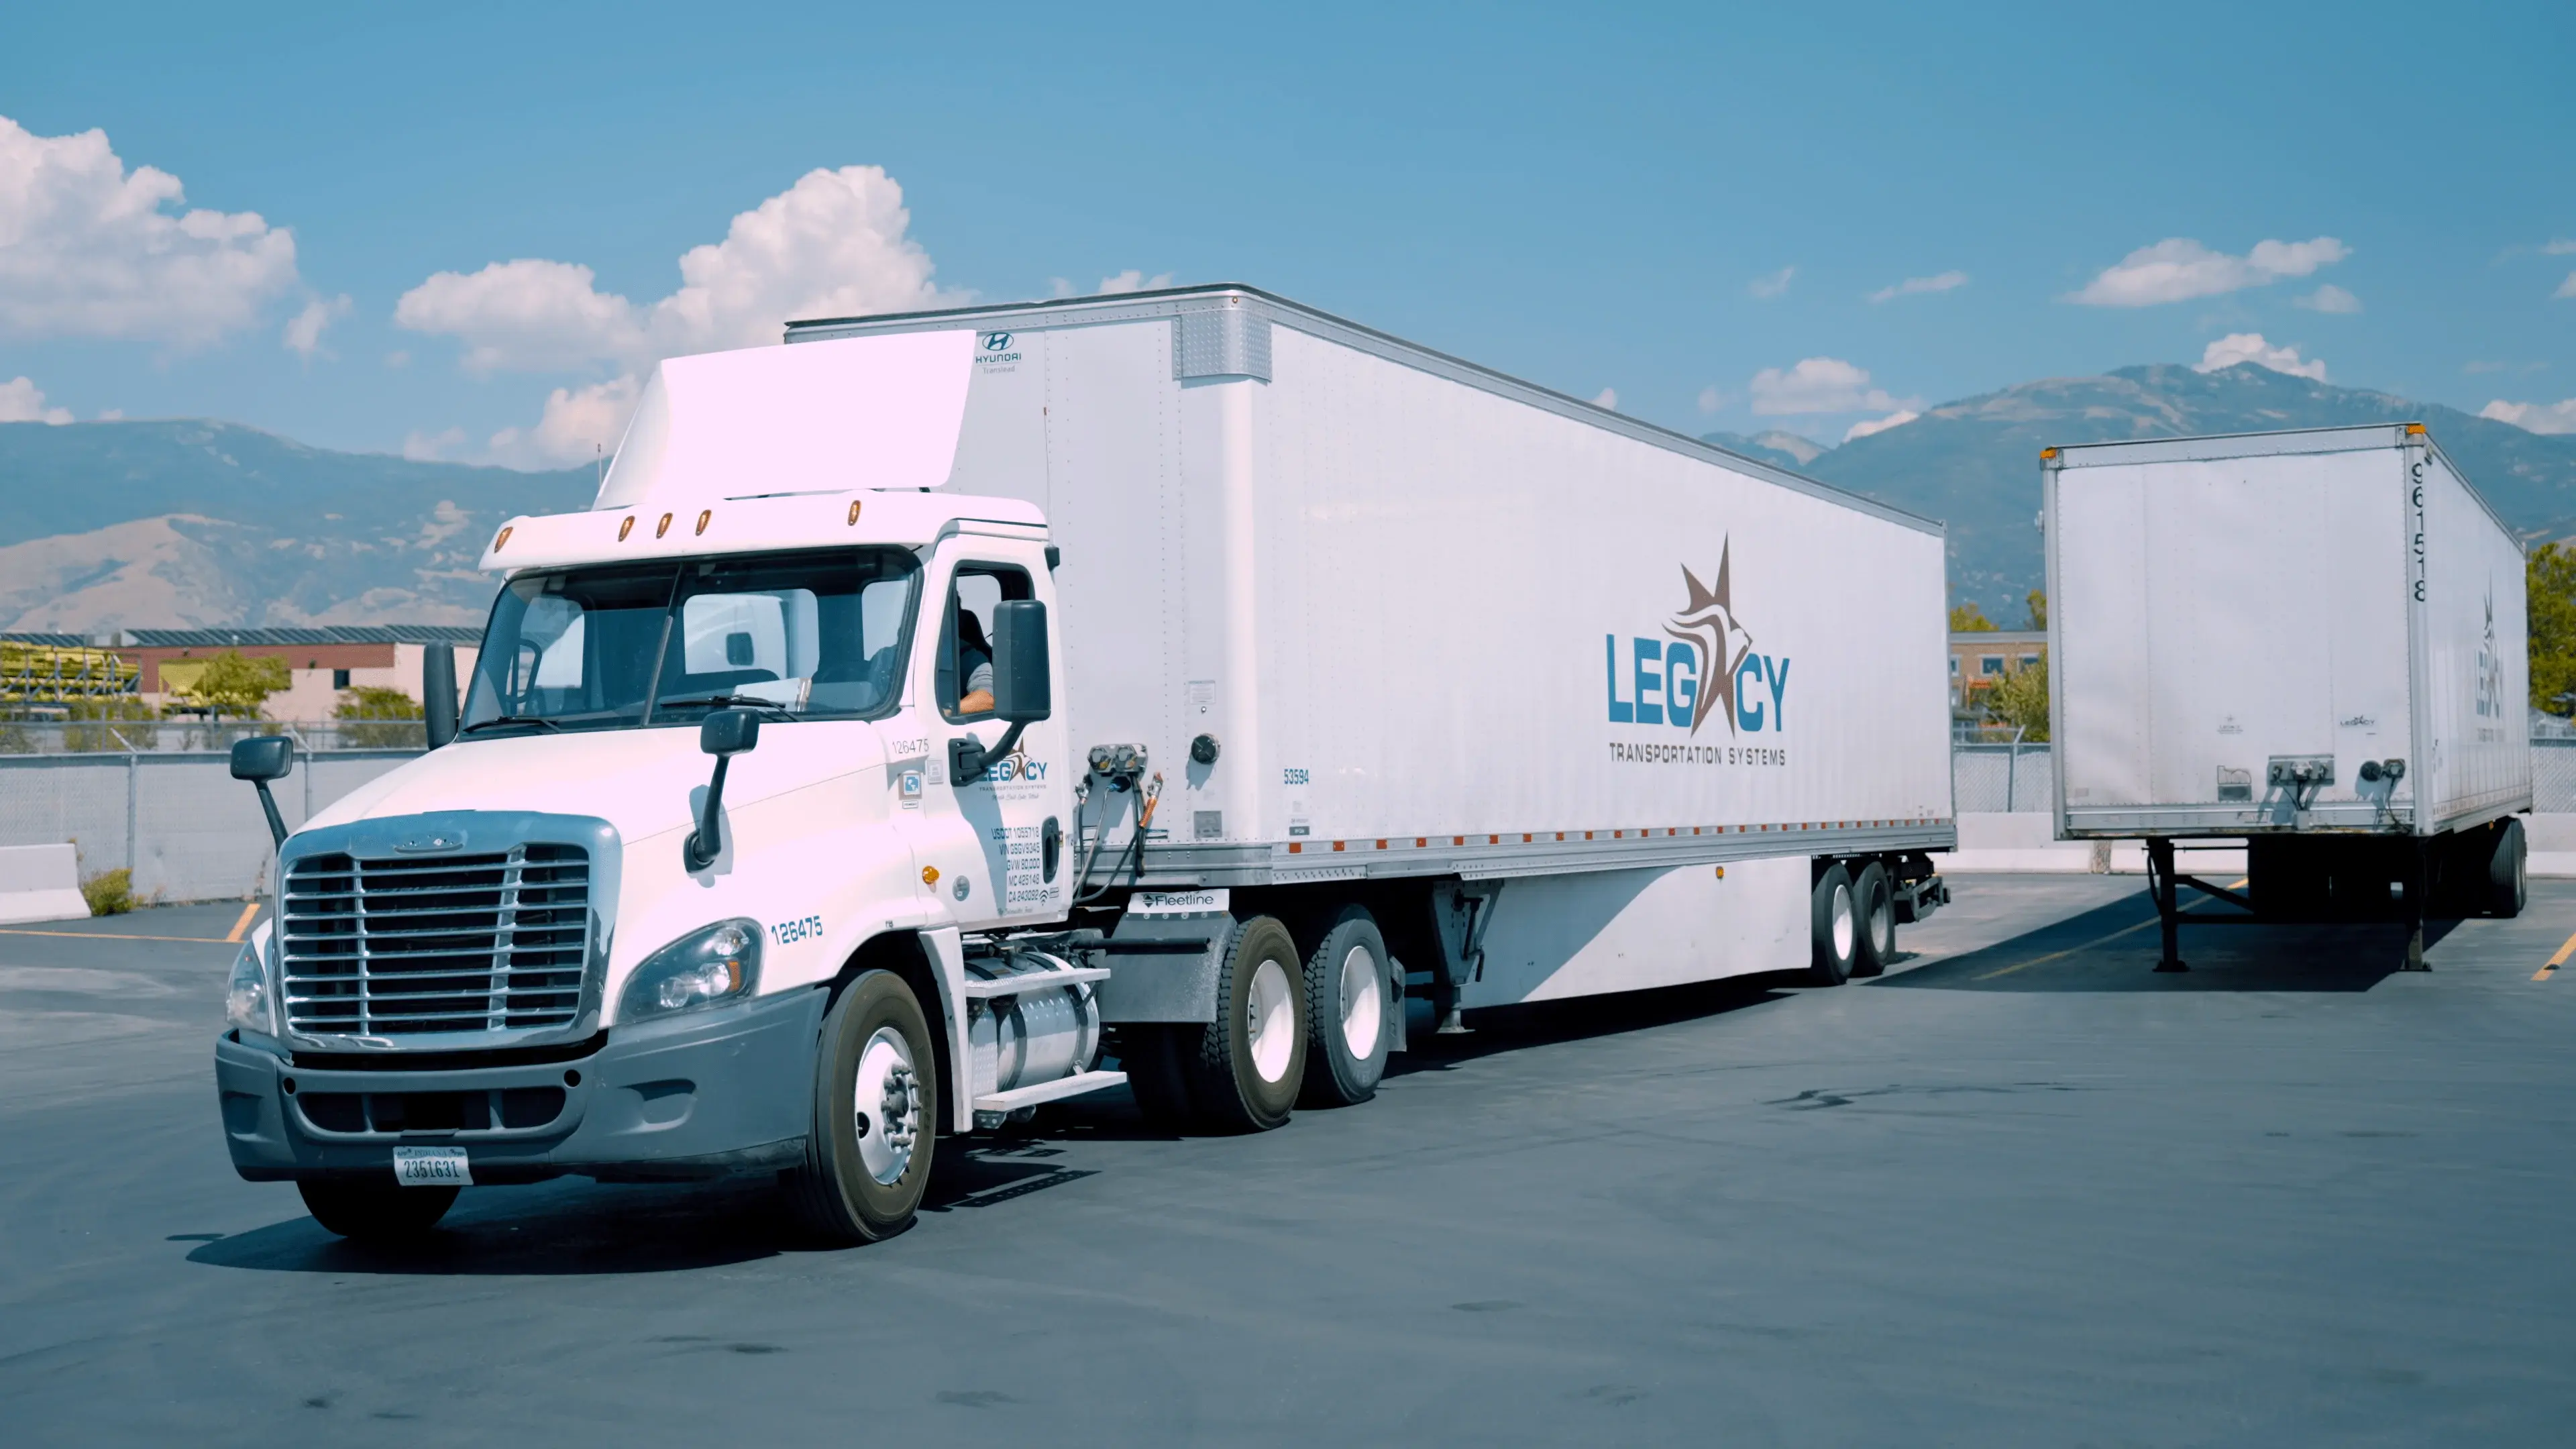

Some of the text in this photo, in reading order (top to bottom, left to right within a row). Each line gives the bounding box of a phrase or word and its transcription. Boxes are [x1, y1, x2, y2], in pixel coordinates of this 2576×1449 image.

[975, 352, 1022, 364] HYUNDAI
[982, 366, 1016, 374] Translead
[2411, 462, 2426, 602] 961518
[1606, 634, 1790, 738] LEGACY
[892, 739, 930, 755] 126475
[1609, 742, 1786, 766] TRANSPORTATION SYSTEMS
[1284, 768, 1309, 785] 53594
[999, 843, 1009, 855] VIN
[1007, 859, 1020, 871] GVW
[1008, 875, 1017, 886] MC
[1008, 891, 1016, 902] CA
[1155, 894, 1214, 906] Fleetline
[771, 915, 823, 946] 126475
[414, 1148, 447, 1157] INDIANA
[404, 1161, 460, 1178] 2351631
